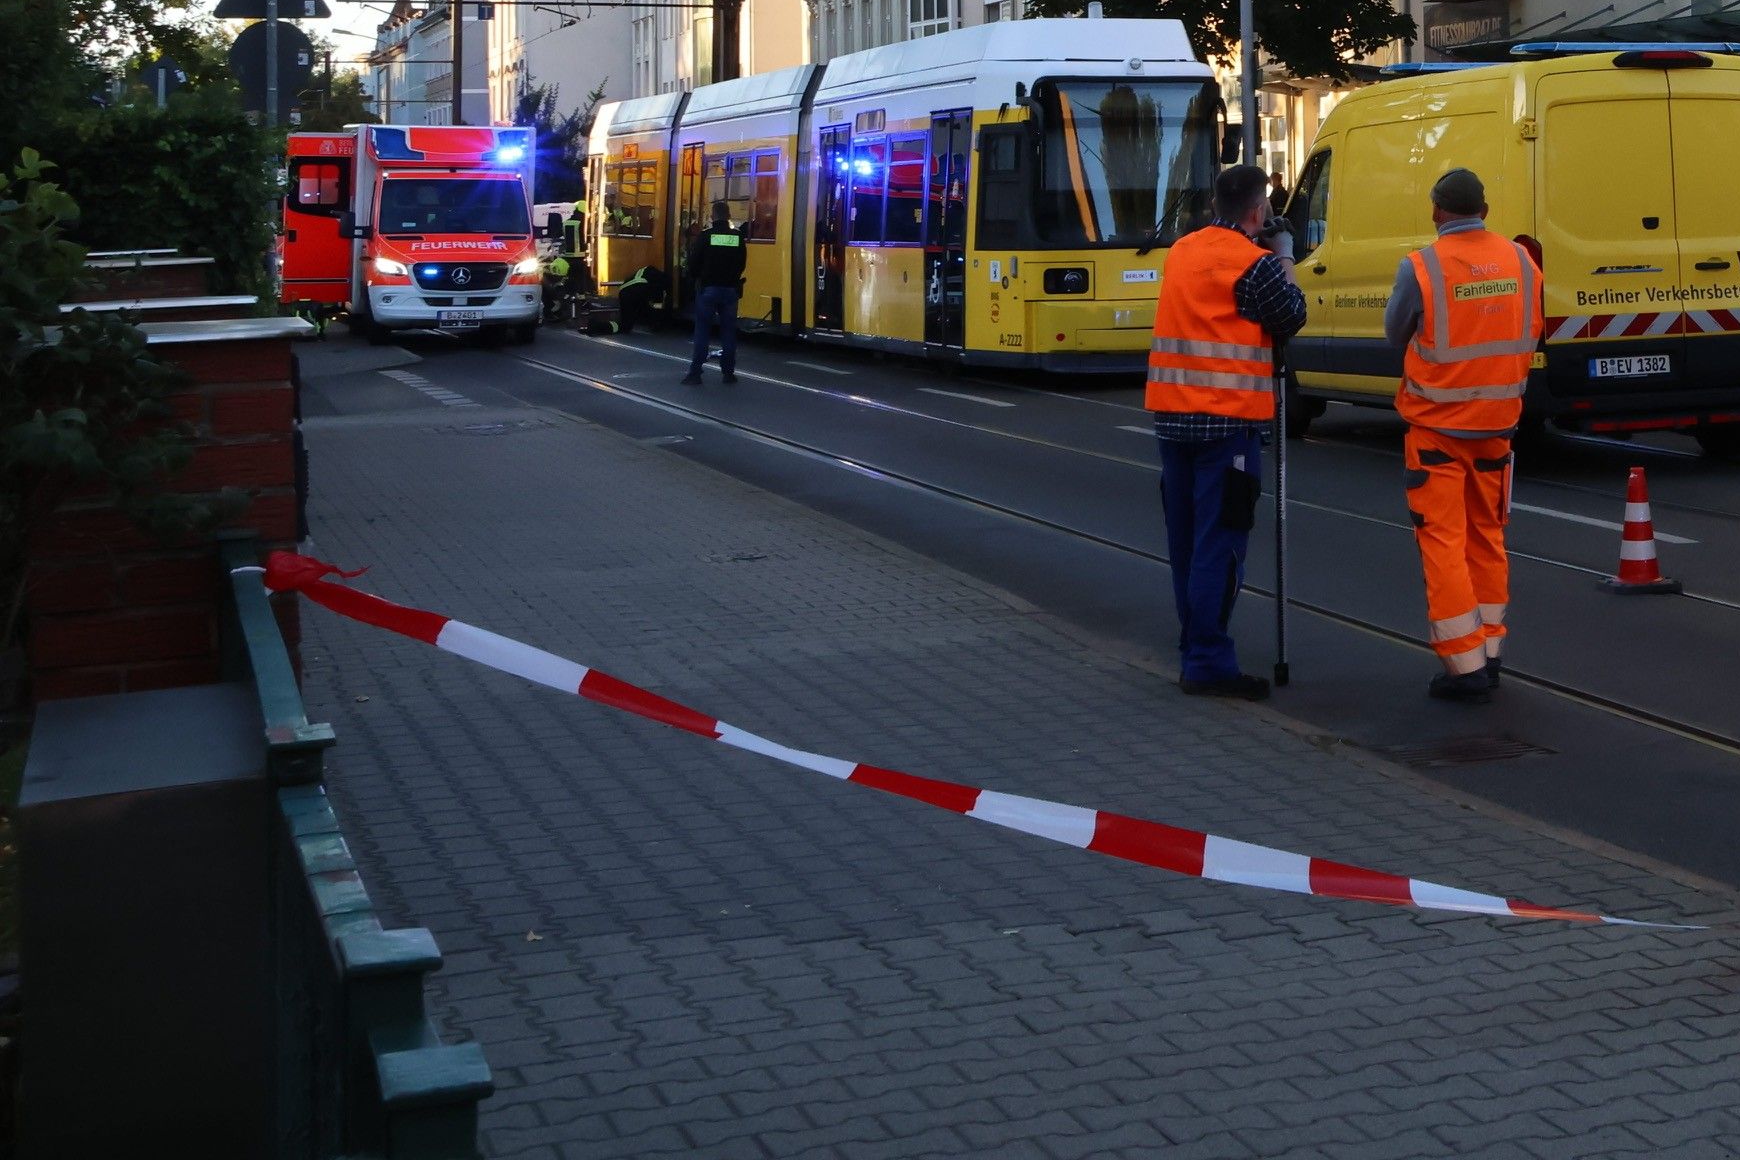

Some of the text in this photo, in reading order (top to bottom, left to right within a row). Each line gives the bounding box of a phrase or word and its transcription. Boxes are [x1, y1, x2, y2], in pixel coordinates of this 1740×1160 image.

[411, 241, 508, 251] FEUERWEHR
[1454, 281, 1518, 299] Fahrleitung
[1576, 289, 1641, 307] Berliner
[1334, 294, 1358, 308] Berliner
[1000, 333, 1022, 347] A-2222
[1600, 357, 1667, 375] B EV 1382
